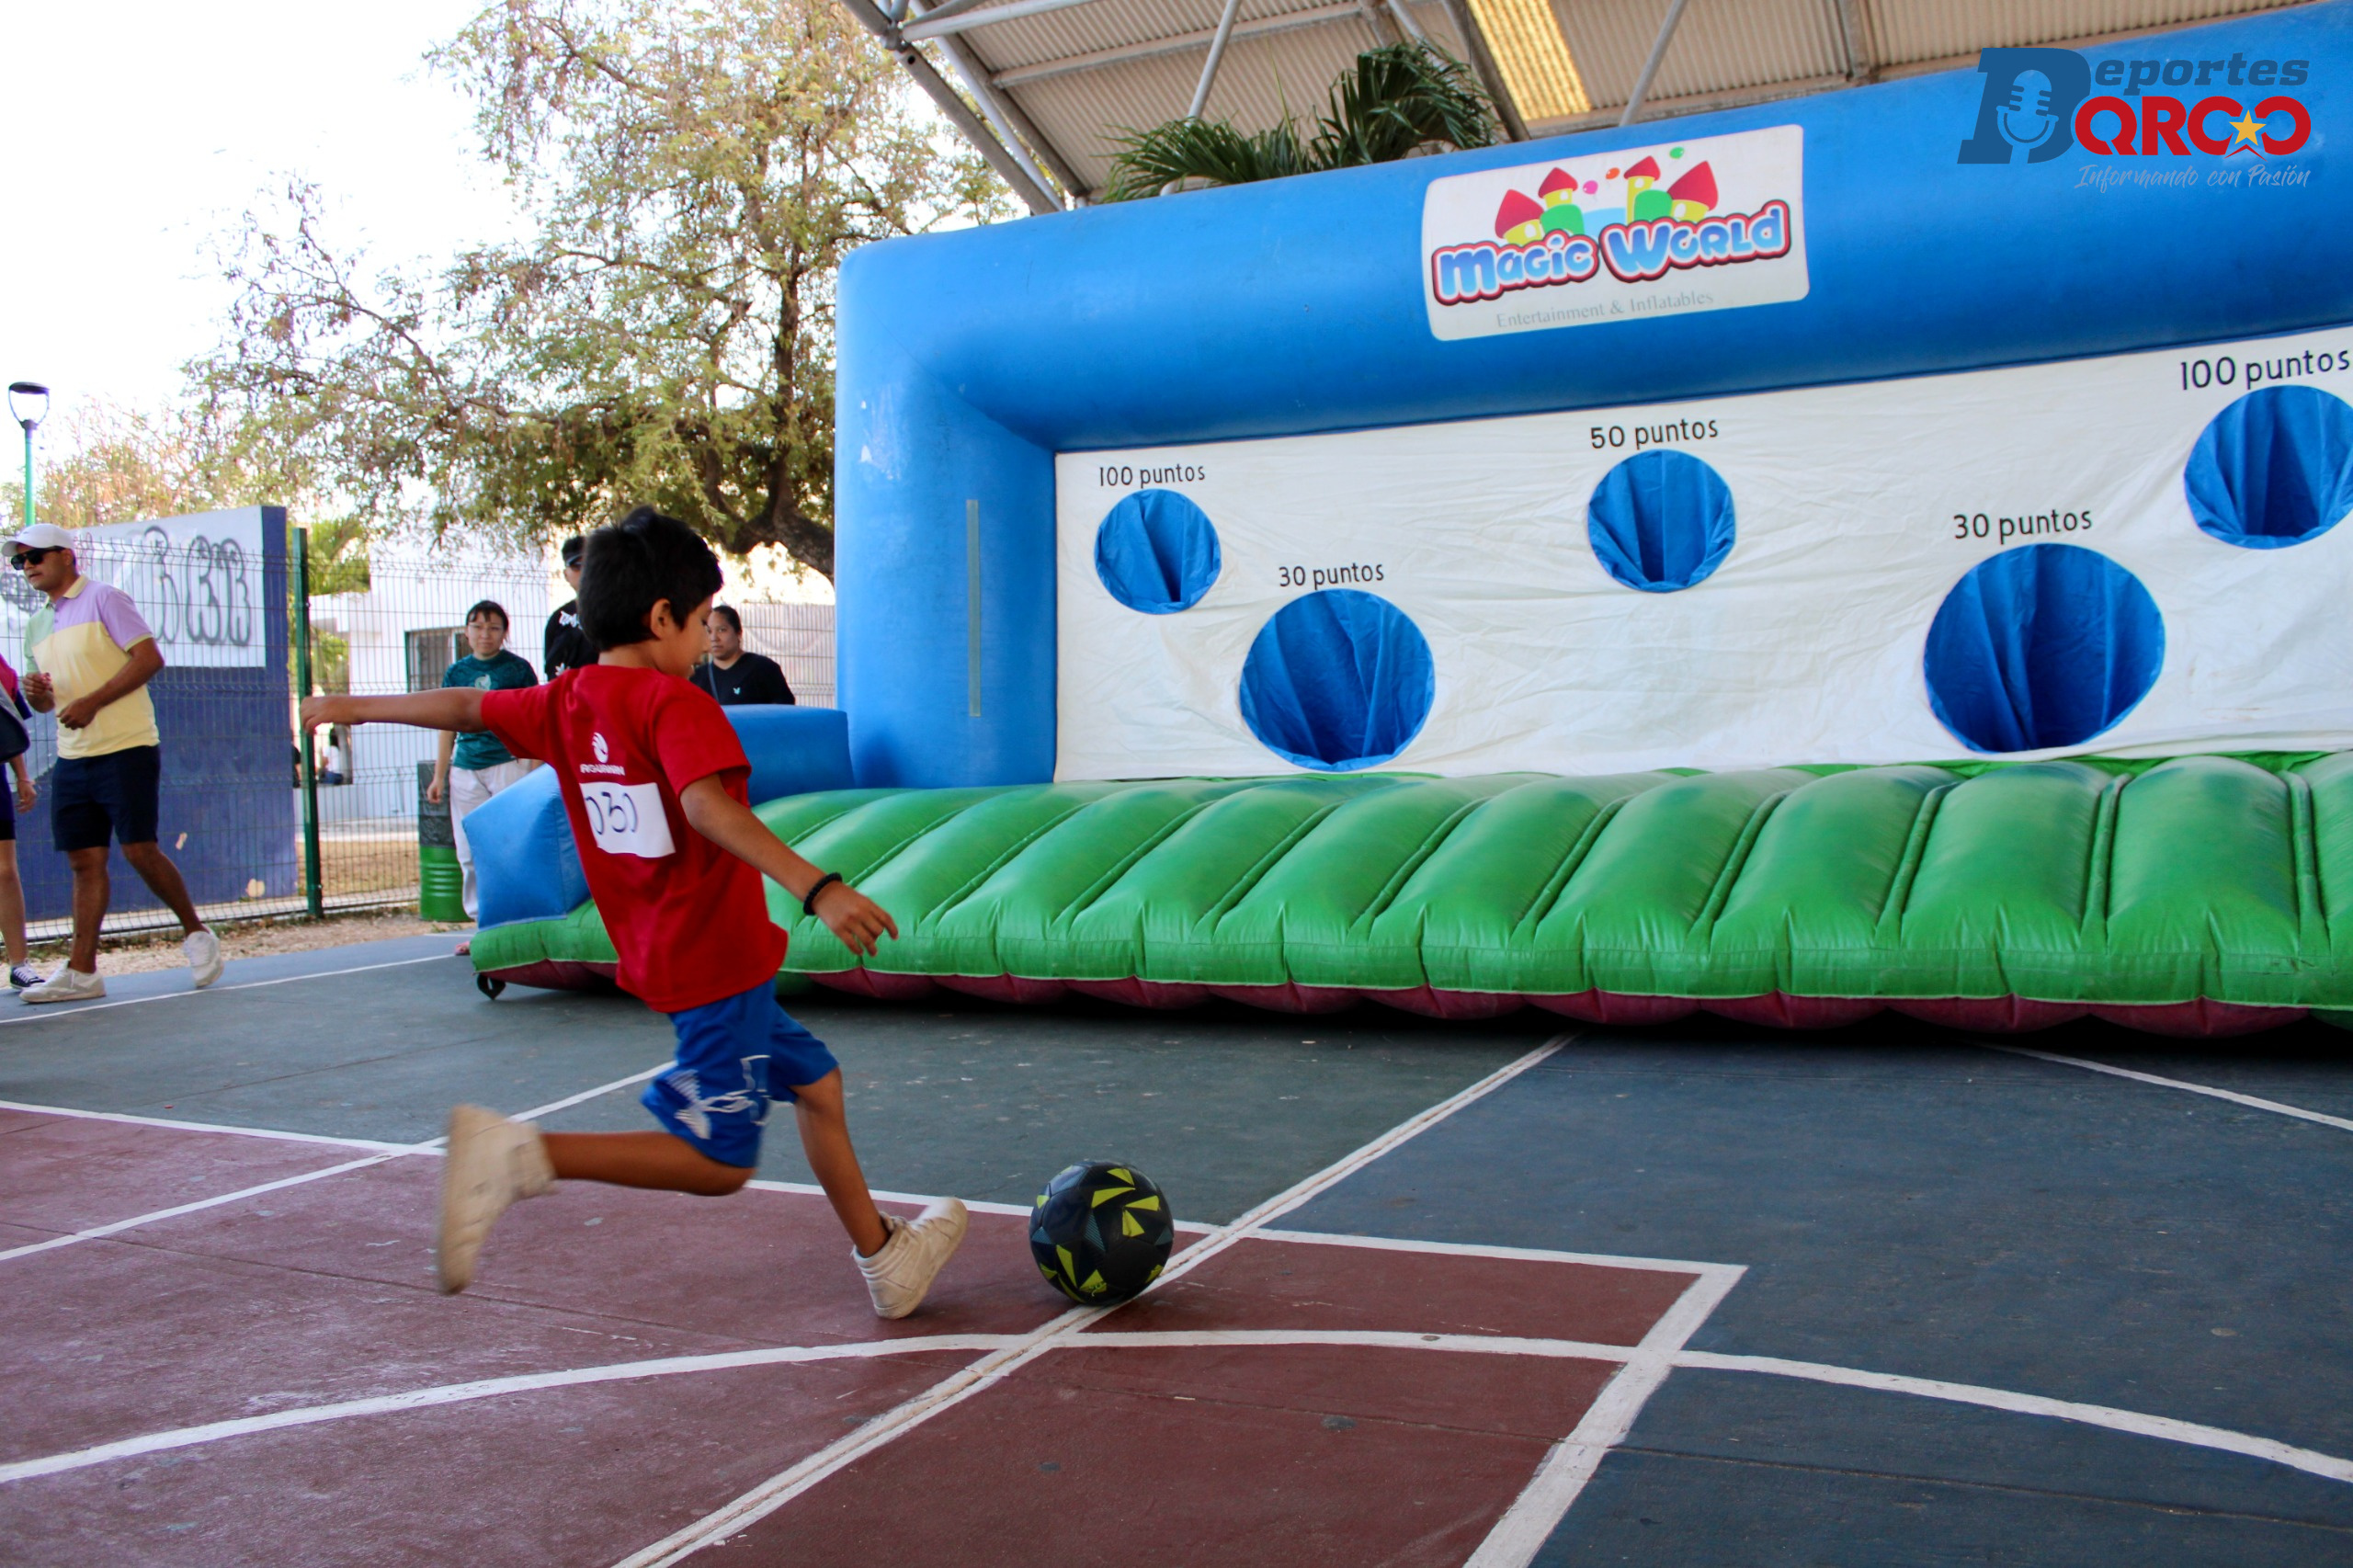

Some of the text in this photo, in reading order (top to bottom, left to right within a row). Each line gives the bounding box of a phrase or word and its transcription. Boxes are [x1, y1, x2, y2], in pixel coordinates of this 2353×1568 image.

[1496, 290, 1714, 328] Entertainment & Inflatables
[2181, 350, 2350, 391] 100 puntos
[1591, 418, 1718, 450] 50 puntos
[1100, 463, 1205, 489] 100 puntos
[1953, 509, 2092, 545] 30 puntos
[1279, 562, 1384, 590] 30 puntos
